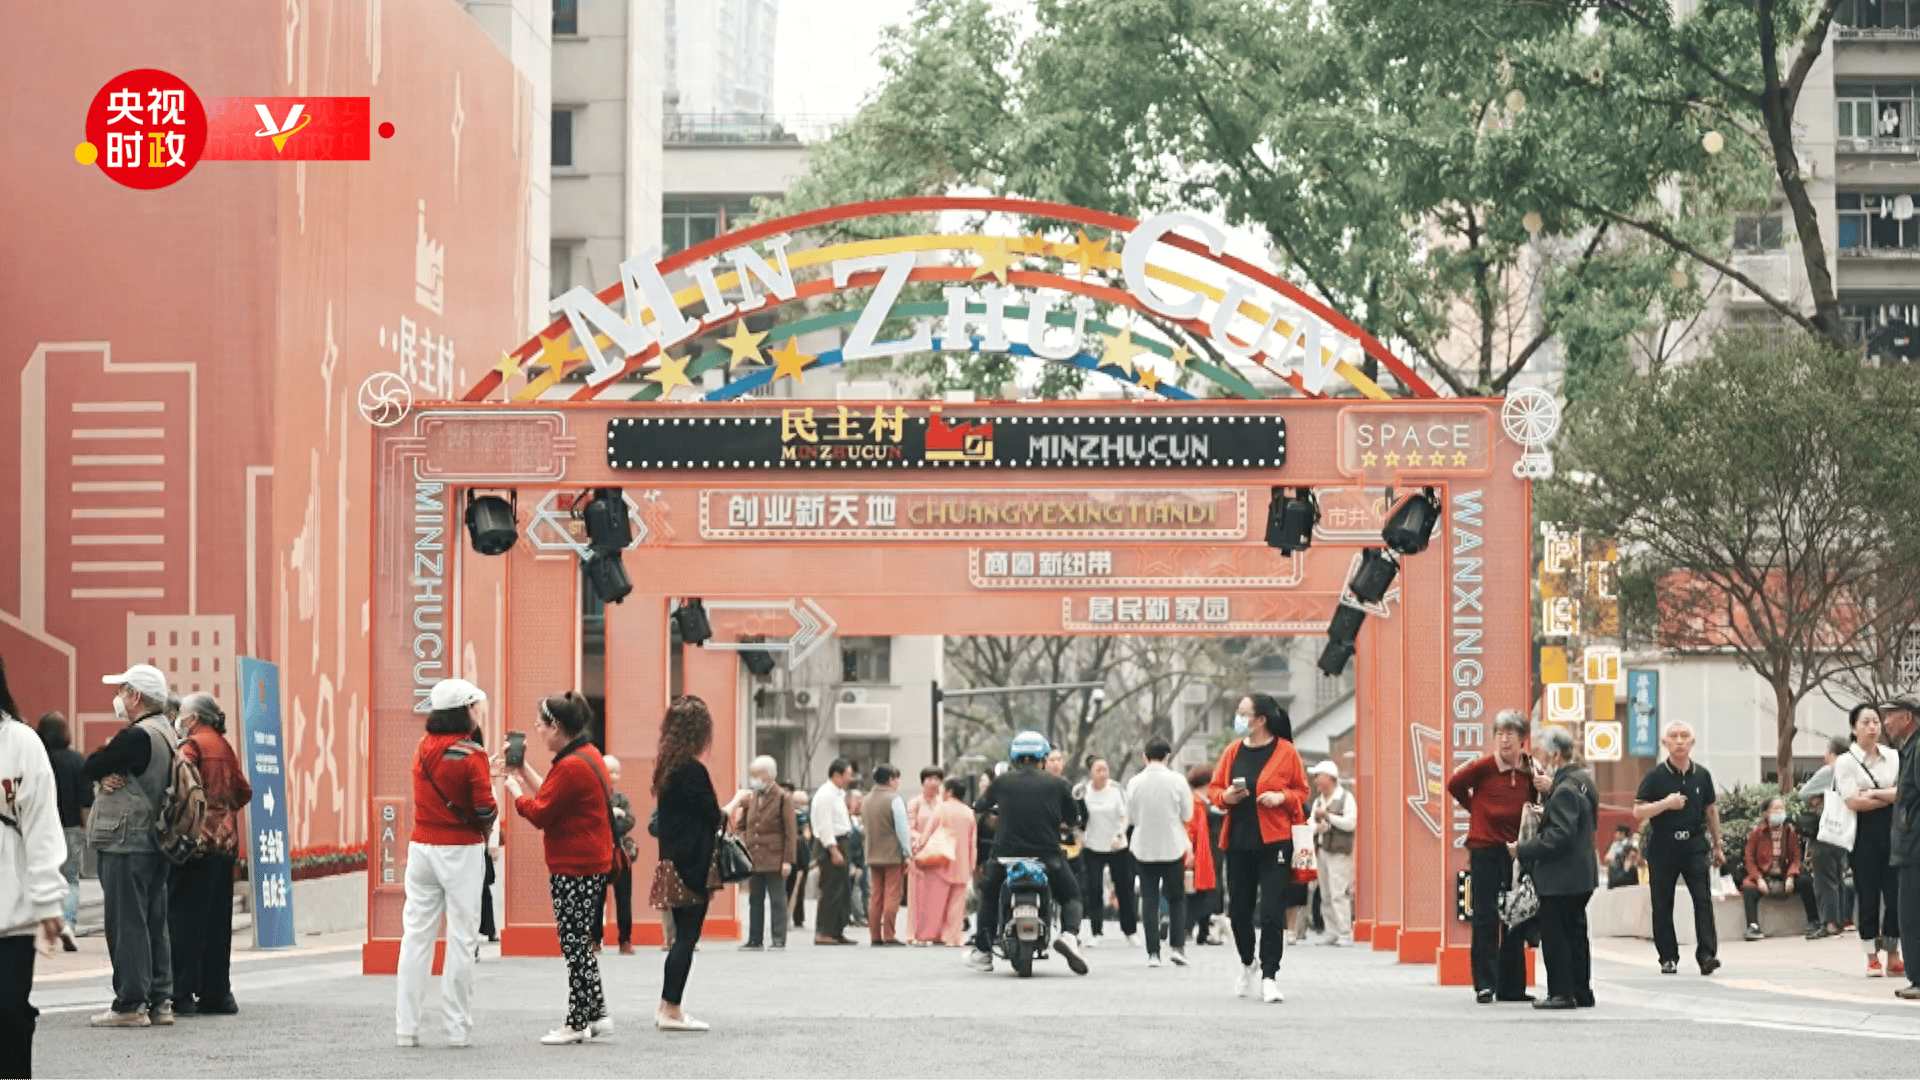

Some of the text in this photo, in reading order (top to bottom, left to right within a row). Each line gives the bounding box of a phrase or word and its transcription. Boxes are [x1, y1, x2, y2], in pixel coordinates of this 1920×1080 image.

[400, 314, 455, 401] 民主村
[781, 405, 909, 443] 民主村
[1357, 423, 1470, 448] SPACE
[781, 445, 902, 460] MINZHUCUN
[1029, 435, 1208, 459] MINZHUCUN
[728, 495, 896, 528] 创业新天地
[1328, 507, 1369, 526] 市井
[1089, 597, 1229, 623] 居民新家园
[382, 804, 395, 883] SALE
